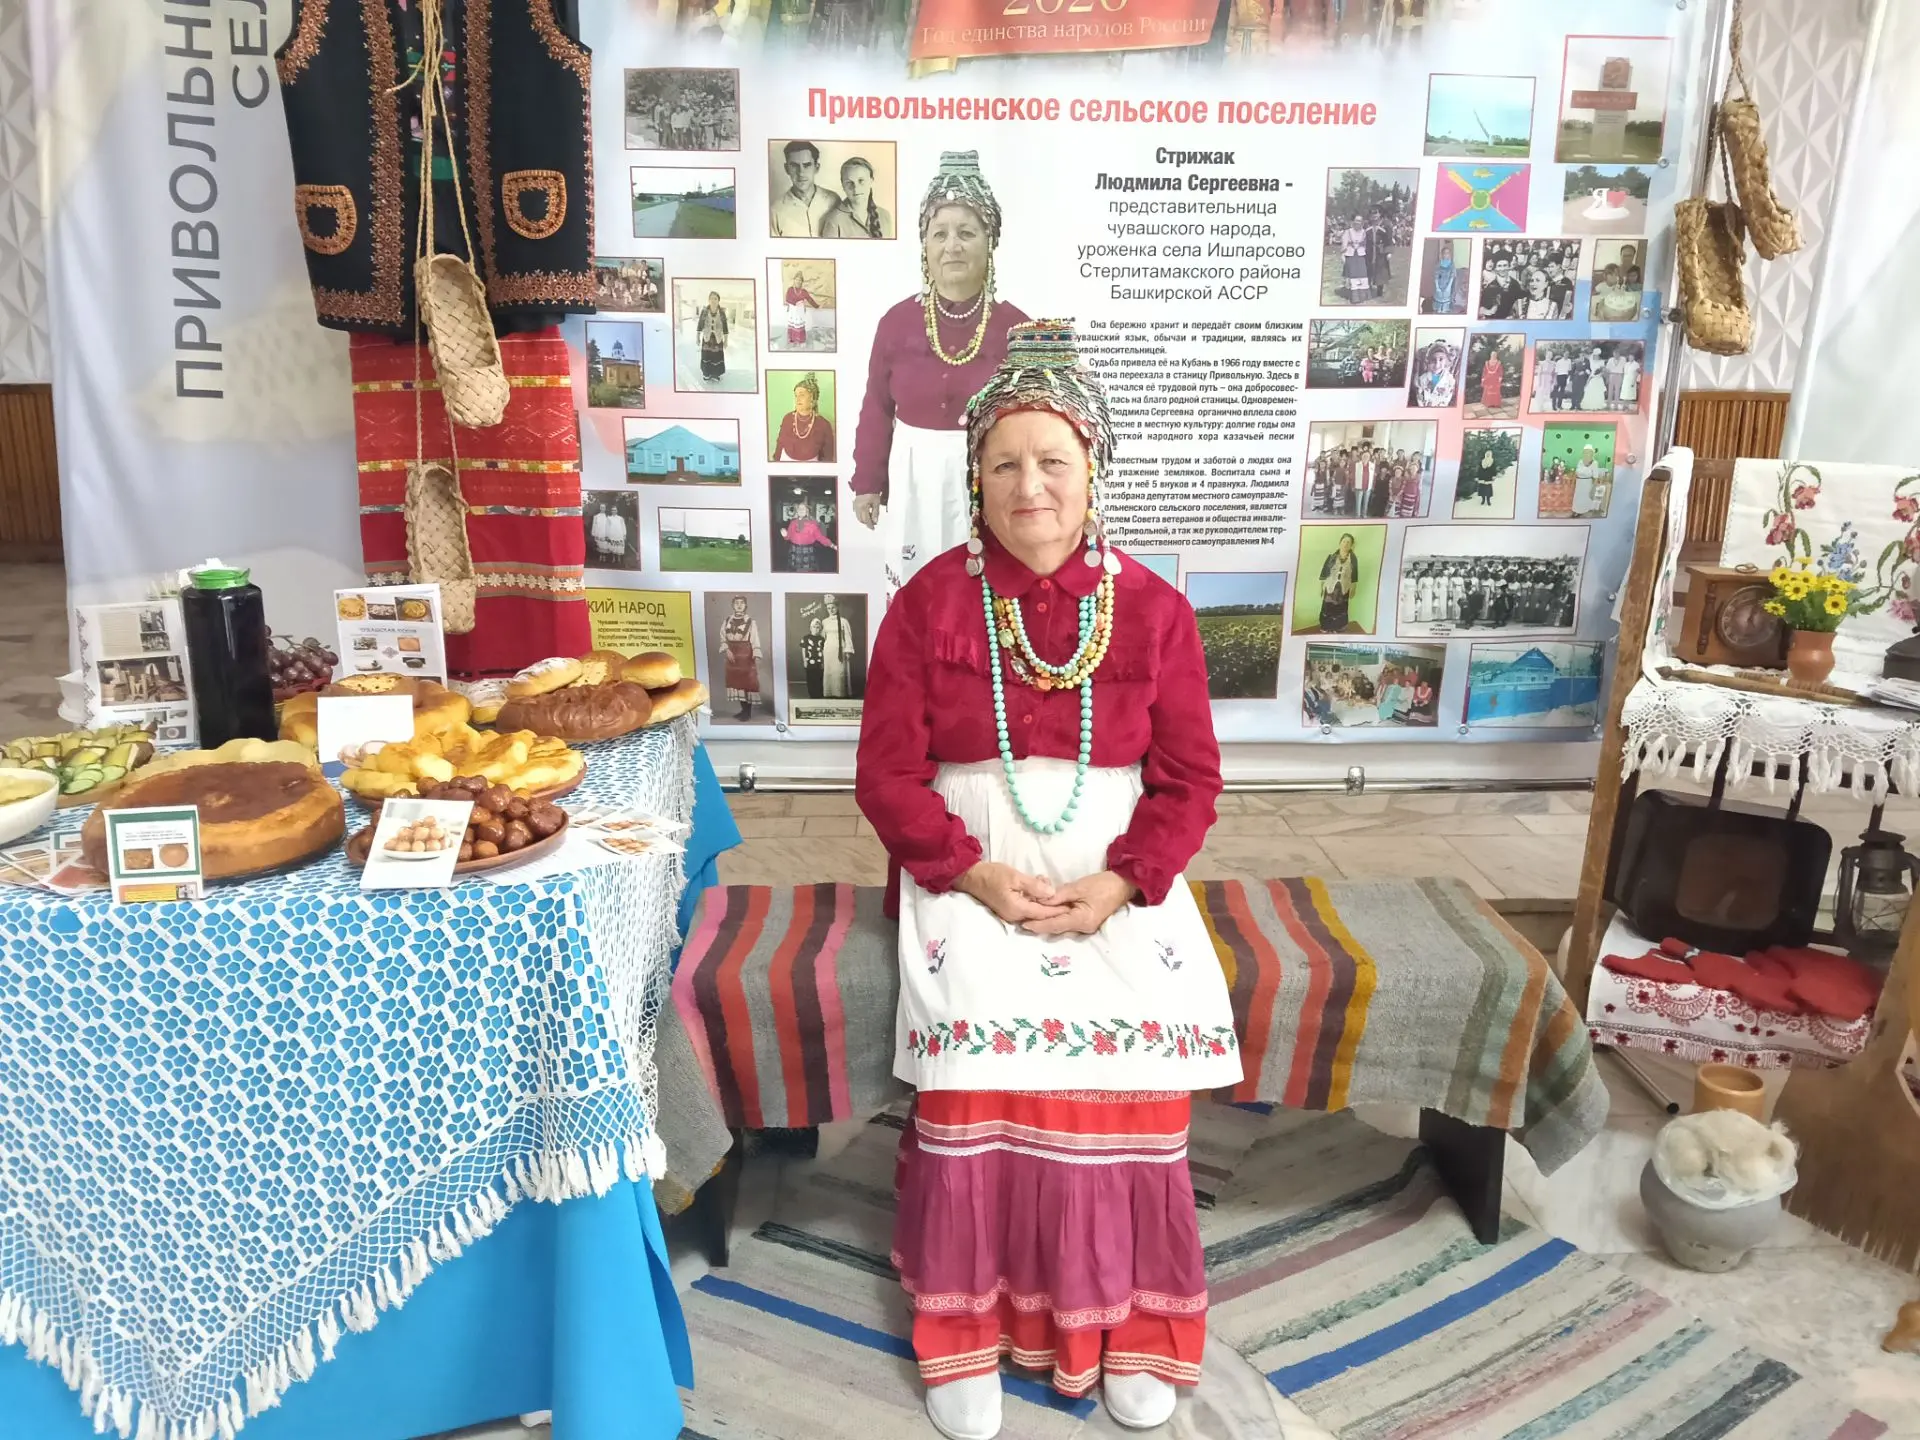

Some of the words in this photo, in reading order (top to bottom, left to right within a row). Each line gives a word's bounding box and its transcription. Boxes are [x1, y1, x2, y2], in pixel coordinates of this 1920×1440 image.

[961, 24, 1047, 42] единства
[1053, 21, 1133, 41] народов
[808, 88, 1060, 123] Привольненское
[1069, 97, 1208, 124] сельское
[1217, 100, 1377, 125] поселение
[1156, 147, 1235, 167] Стрижак
[1095, 173, 1181, 192] Людмила
[1188, 174, 1279, 194] Сергеевна
[163, 0, 223, 399] ПРИВОЛЬН
[1109, 201, 1277, 216] представительница
[1108, 223, 1204, 238] чувашского
[1210, 224, 1275, 239] народа,
[1077, 244, 1156, 259] уроженка
[1162, 245, 1201, 256] села
[1208, 243, 1305, 260] Ишпарсово
[1080, 263, 1234, 281] Стерлитамакского
[1240, 266, 1301, 282] района
[1111, 285, 1212, 302] Башкирской
[1218, 285, 1268, 299] АССР
[1091, 320, 1106, 328] Она
[1110, 320, 1146, 330] бережно
[1150, 322, 1179, 330] хранит
[1192, 321, 1231, 331] передаёт
[1265, 321, 1303, 329] близким
[1154, 333, 1186, 341] обычаи
[1202, 335, 1246, 343] традиции,
[1100, 346, 1166, 355] носительницей.
[1089, 358, 1119, 368] Судьба
[1121, 360, 1156, 368] привела
[1182, 358, 1211, 368] Кубань
[1221, 359, 1240, 367] 1966
[1242, 360, 1261, 368] году
[1120, 372, 1163, 380] переехала
[1173, 372, 1207, 380] станицу
[1210, 371, 1264, 380] Привольную.
[1267, 371, 1292, 380] Здесь
[1146, 383, 1155, 391] её
[1158, 385, 1196, 393] трудовой
[1199, 385, 1218, 393] путь
[1245, 383, 1298, 393] добросовес-
[1144, 395, 1167, 403] благо
[1169, 396, 1199, 405] родной
[1241, 396, 1297, 405] Одновремен-
[1151, 408, 1194, 417] Сергеевна
[1114, 432, 1143, 441] сткой
[1111, 456, 1158, 465] совестным
[1162, 458, 1191, 466] трудом
[1203, 456, 1236, 464] заботой
[1211, 468, 1255, 476] Воспитала
[1105, 481, 1124, 489] одня
[1135, 480, 1149, 488] неё
[1152, 480, 1157, 488] 5
[1251, 480, 1289, 488] Людмила
[1111, 492, 1145, 501] избрана
[1147, 493, 1190, 501] депутатом
[1231, 492, 1288, 500] самоуправле-
[1103, 505, 1156, 513] ольненского
[1132, 515, 1160, 523] Совета
[1212, 514, 1251, 523] общества
[1119, 527, 1172, 536] Привольной,
[1205, 527, 1268, 535] руководителем
[1129, 538, 1190, 547] общественного
[587, 598, 614, 613] КИЙ
[619, 601, 666, 617] НАРОД
